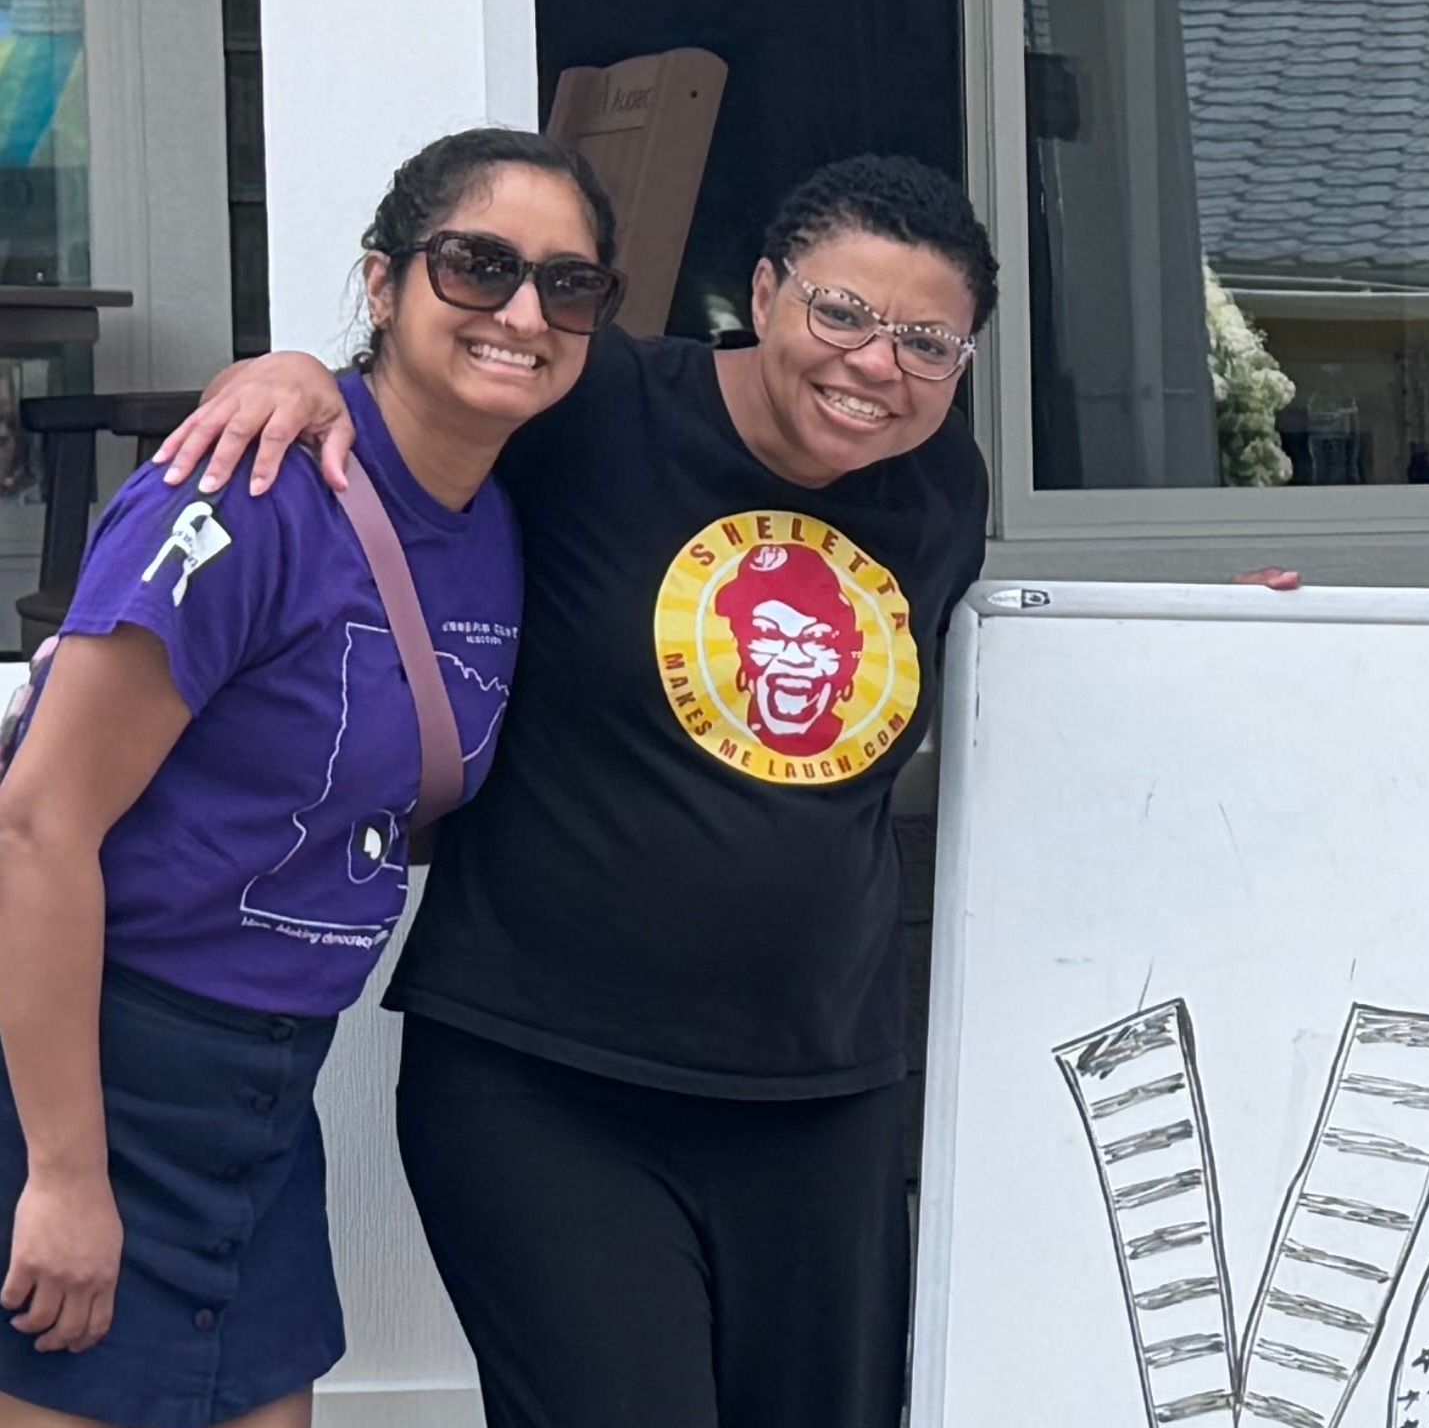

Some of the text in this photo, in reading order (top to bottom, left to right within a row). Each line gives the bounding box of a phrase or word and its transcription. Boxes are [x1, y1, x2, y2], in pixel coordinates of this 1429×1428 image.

[689, 515, 909, 630] SHELETTA
[662, 652, 713, 737] MAKES
[719, 737, 752, 768] ME
